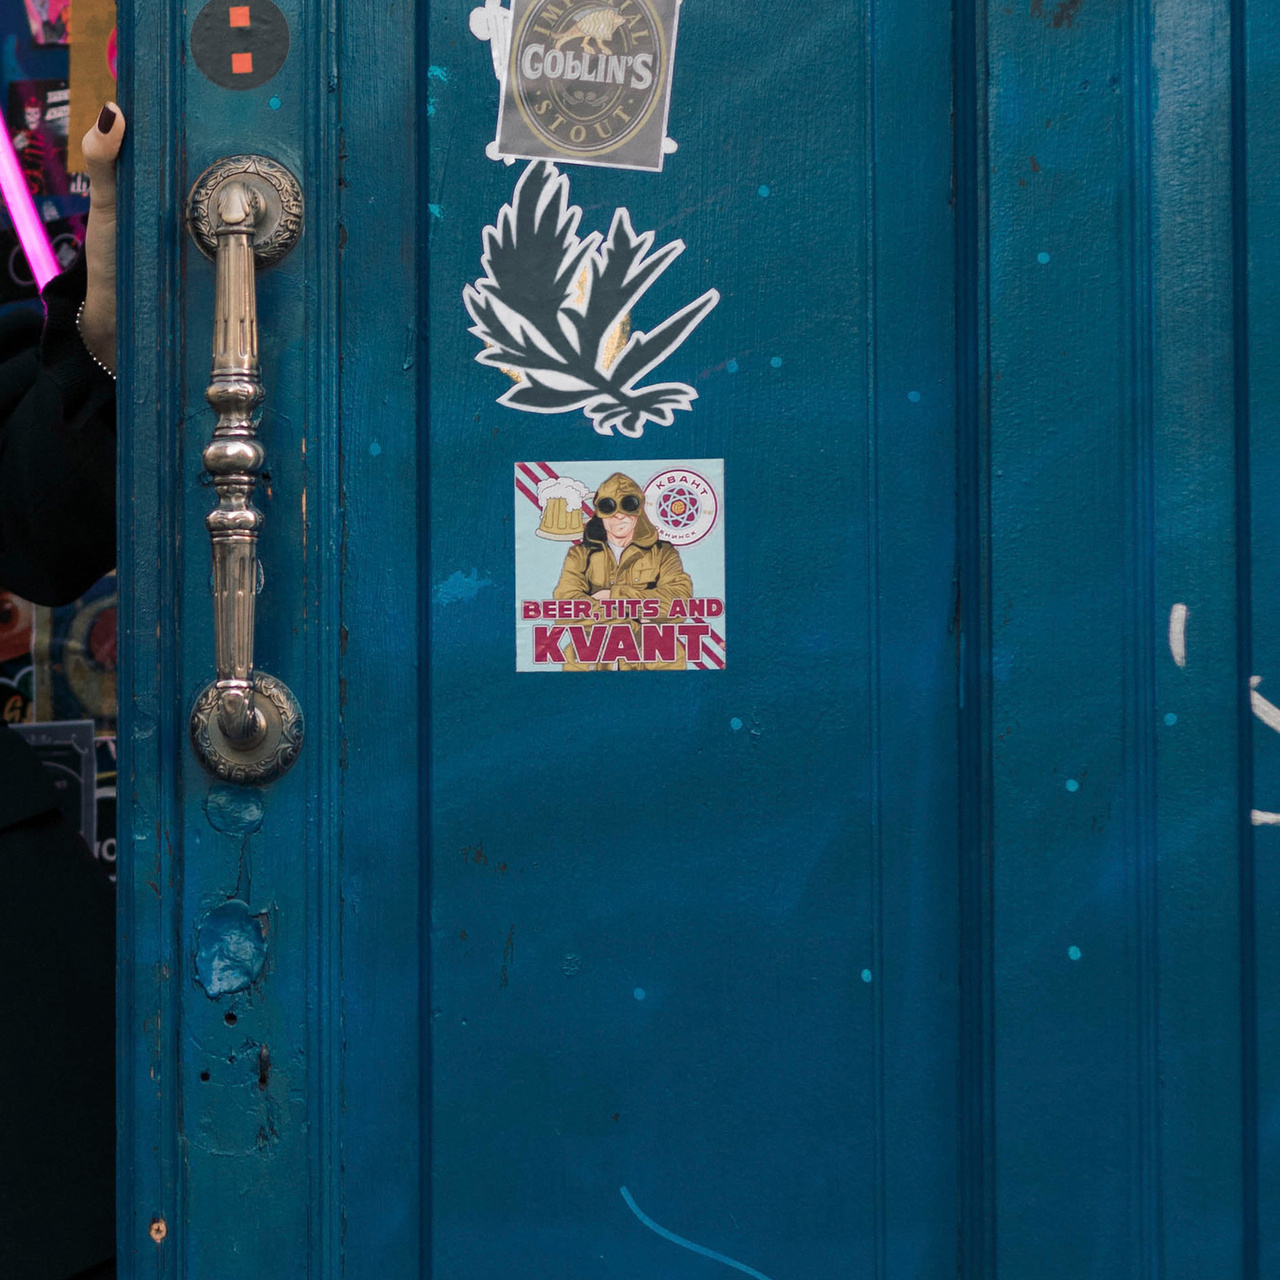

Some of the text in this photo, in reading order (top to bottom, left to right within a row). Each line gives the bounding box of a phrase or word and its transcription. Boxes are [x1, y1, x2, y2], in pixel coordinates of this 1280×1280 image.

[534, 99, 632, 143] STOUT
[669, 598, 724, 619] AND
[533, 624, 712, 664] KVANT
